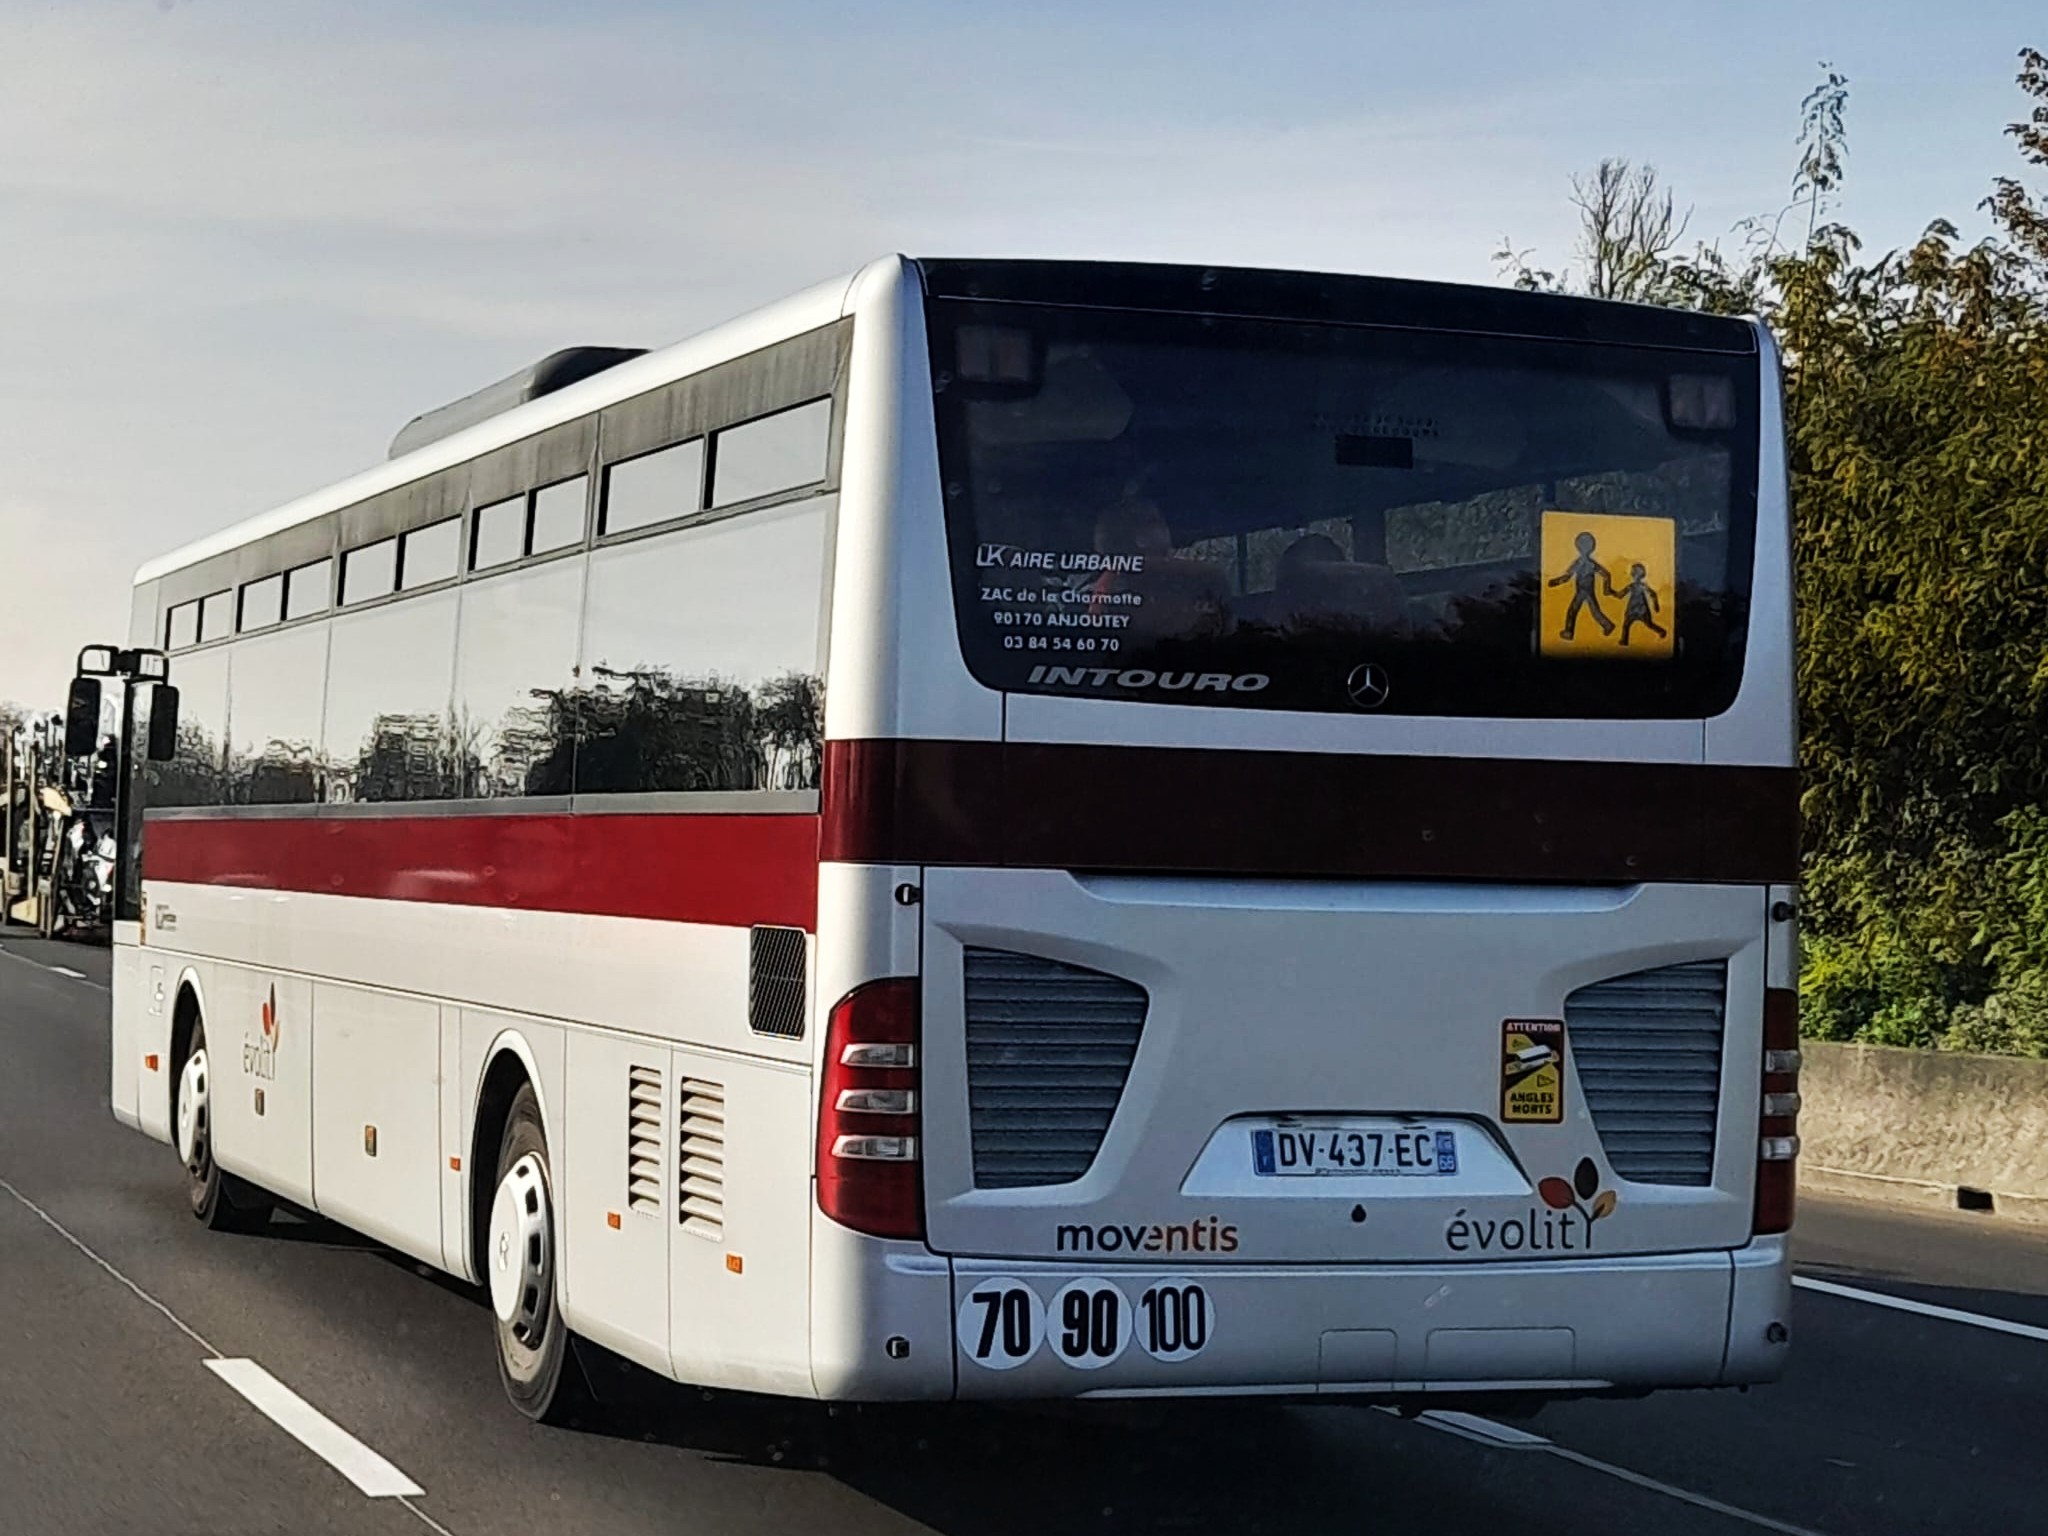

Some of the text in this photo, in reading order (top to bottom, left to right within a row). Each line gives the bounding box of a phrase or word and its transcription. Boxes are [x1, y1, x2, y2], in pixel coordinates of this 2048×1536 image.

[1010, 552, 1056, 569] AIRE
[1060, 554, 1144, 572] URBAINE
[981, 587, 1142, 605] ZAC de la Charmotte
[993, 611, 1130, 628] 90170 ANJOUTEY
[1004, 636, 1119, 651] 03 84 54 60 70
[1028, 666, 1270, 691] INTOURO
[1506, 1023, 1560, 1031] ATTENTION
[1510, 1092, 1554, 1103] ANGLES
[1512, 1104, 1552, 1114] MORTS
[1057, 1216, 1239, 1251] moventis
[972, 1289, 1031, 1358] 70
[1062, 1289, 1119, 1358] 90
[1141, 1285, 1206, 1353] 100
